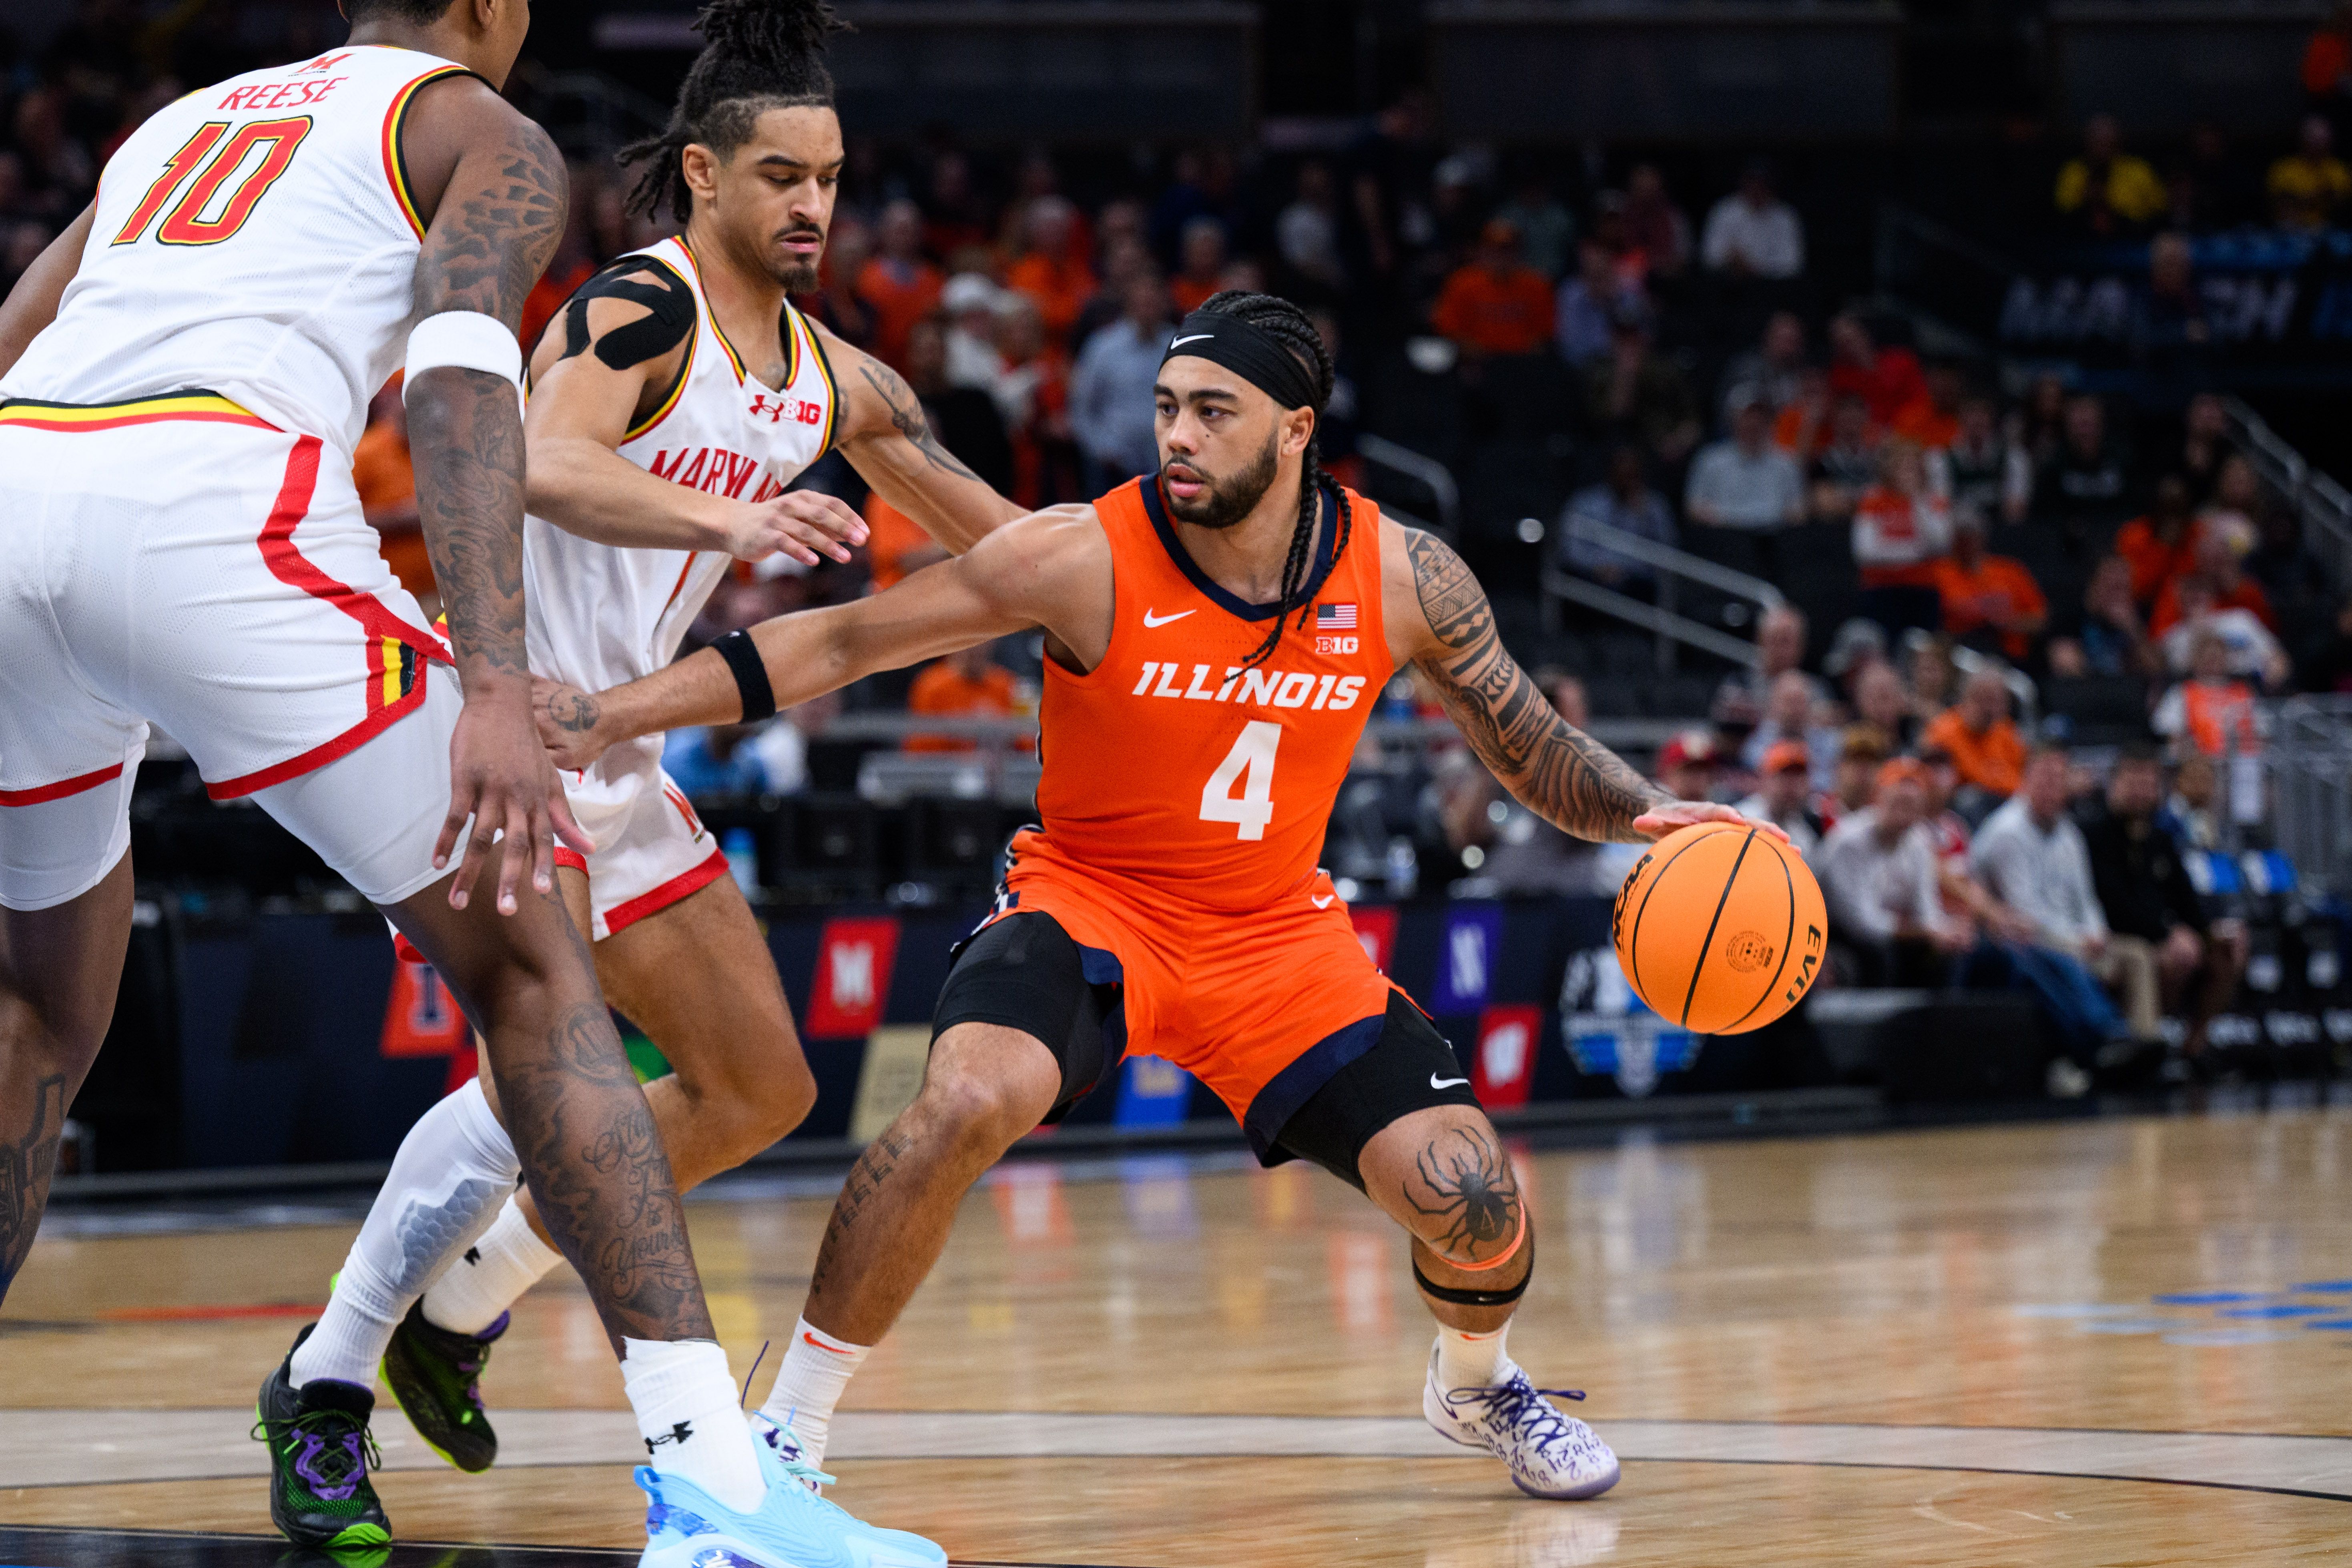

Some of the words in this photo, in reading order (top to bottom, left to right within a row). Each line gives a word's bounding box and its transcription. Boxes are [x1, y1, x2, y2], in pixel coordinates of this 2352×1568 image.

[218, 76, 350, 110] REESE
[109, 115, 313, 247] 10
[1132, 662, 1366, 710] ILLINOIS
[1199, 720, 1282, 841] 4
[1786, 923, 1821, 1002] EVO
